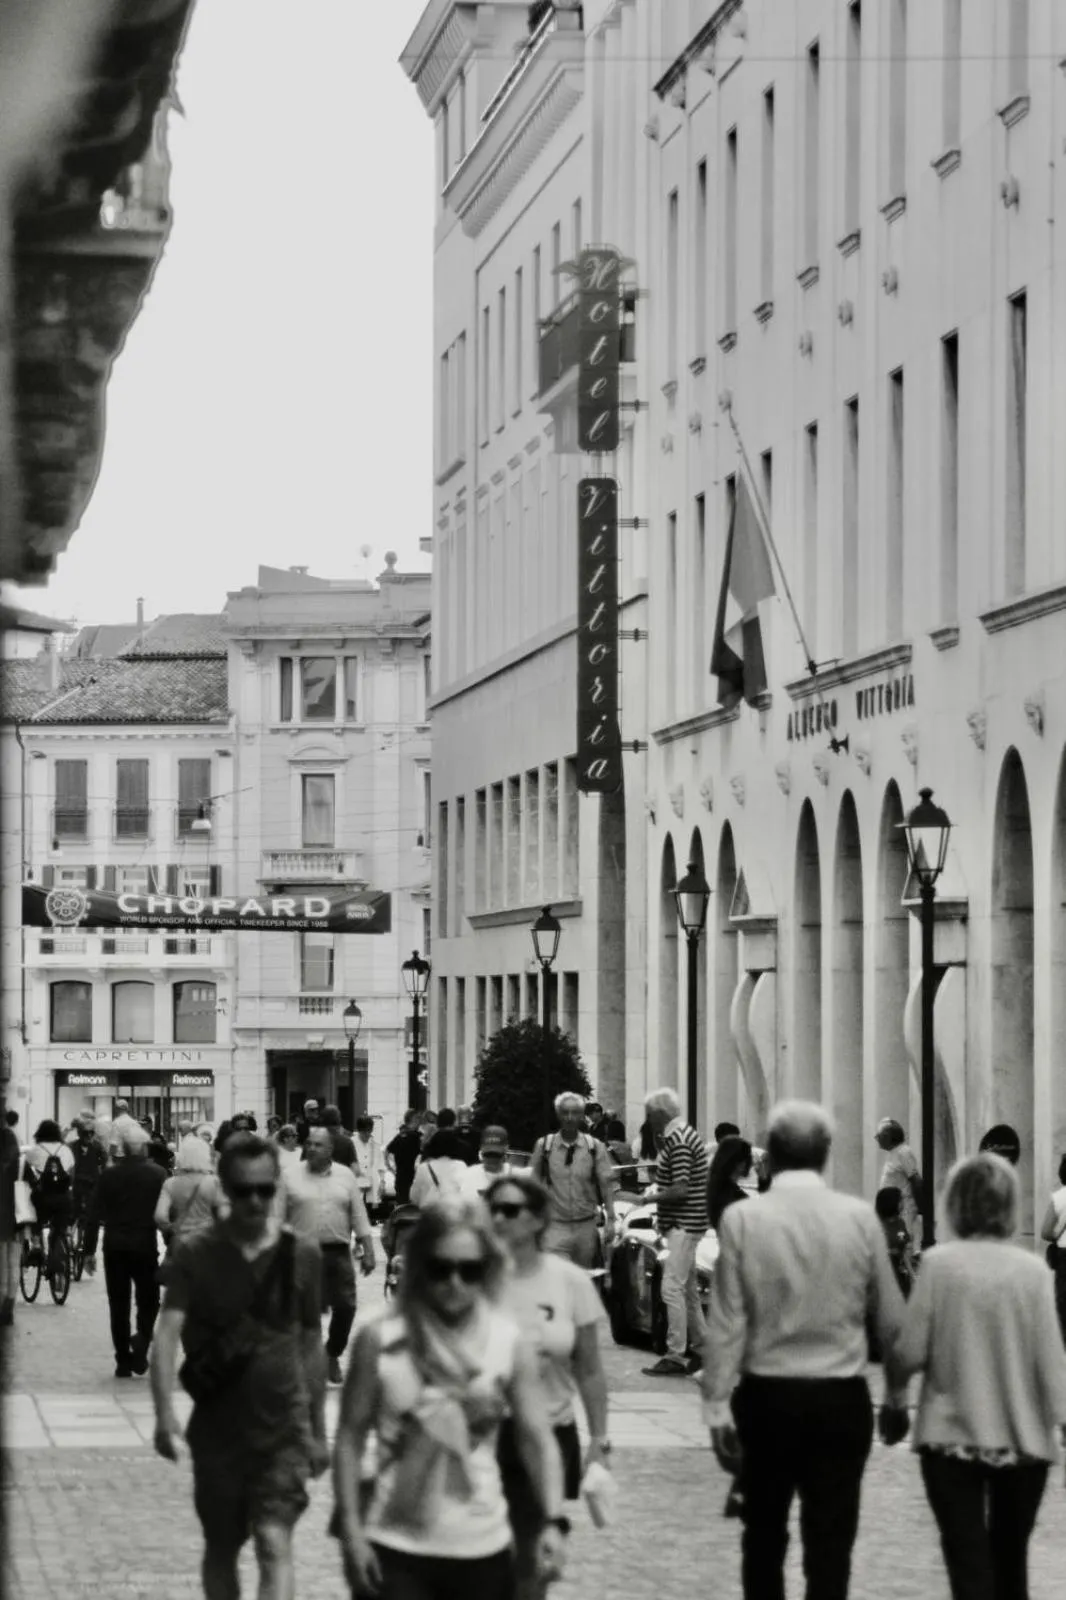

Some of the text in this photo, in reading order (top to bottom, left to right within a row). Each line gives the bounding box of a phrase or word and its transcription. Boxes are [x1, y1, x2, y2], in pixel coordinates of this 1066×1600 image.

[584, 256, 617, 442] Hotel
[581, 485, 611, 779] Vittoria
[117, 893, 331, 917] CHOPARD
[64, 1051, 201, 1061] CAPRETTINI
